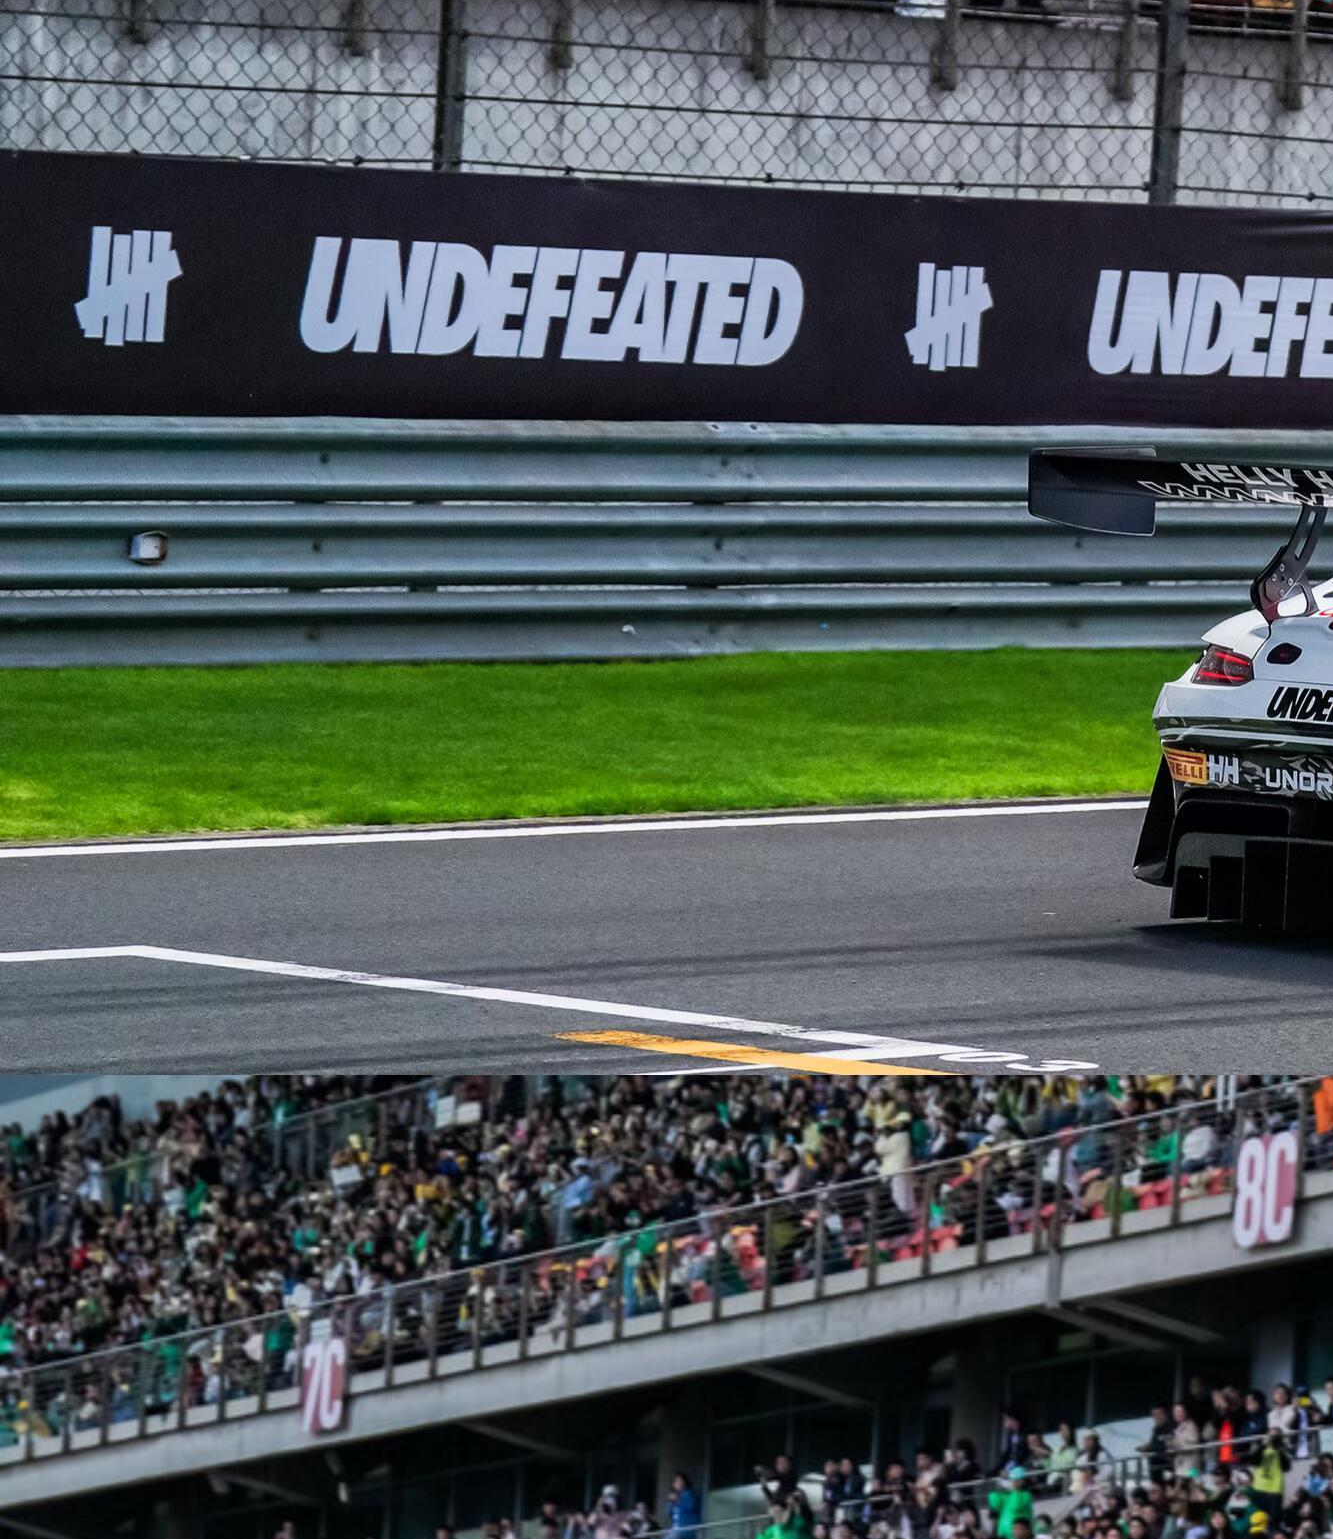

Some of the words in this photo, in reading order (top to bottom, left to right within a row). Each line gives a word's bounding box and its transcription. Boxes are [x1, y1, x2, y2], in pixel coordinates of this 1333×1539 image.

[300, 236, 803, 366] UNDEFEATED
[1181, 463, 1298, 487] HELLY
[1234, 1131, 1296, 1247] 8C
[301, 1336, 345, 1434] 7C
